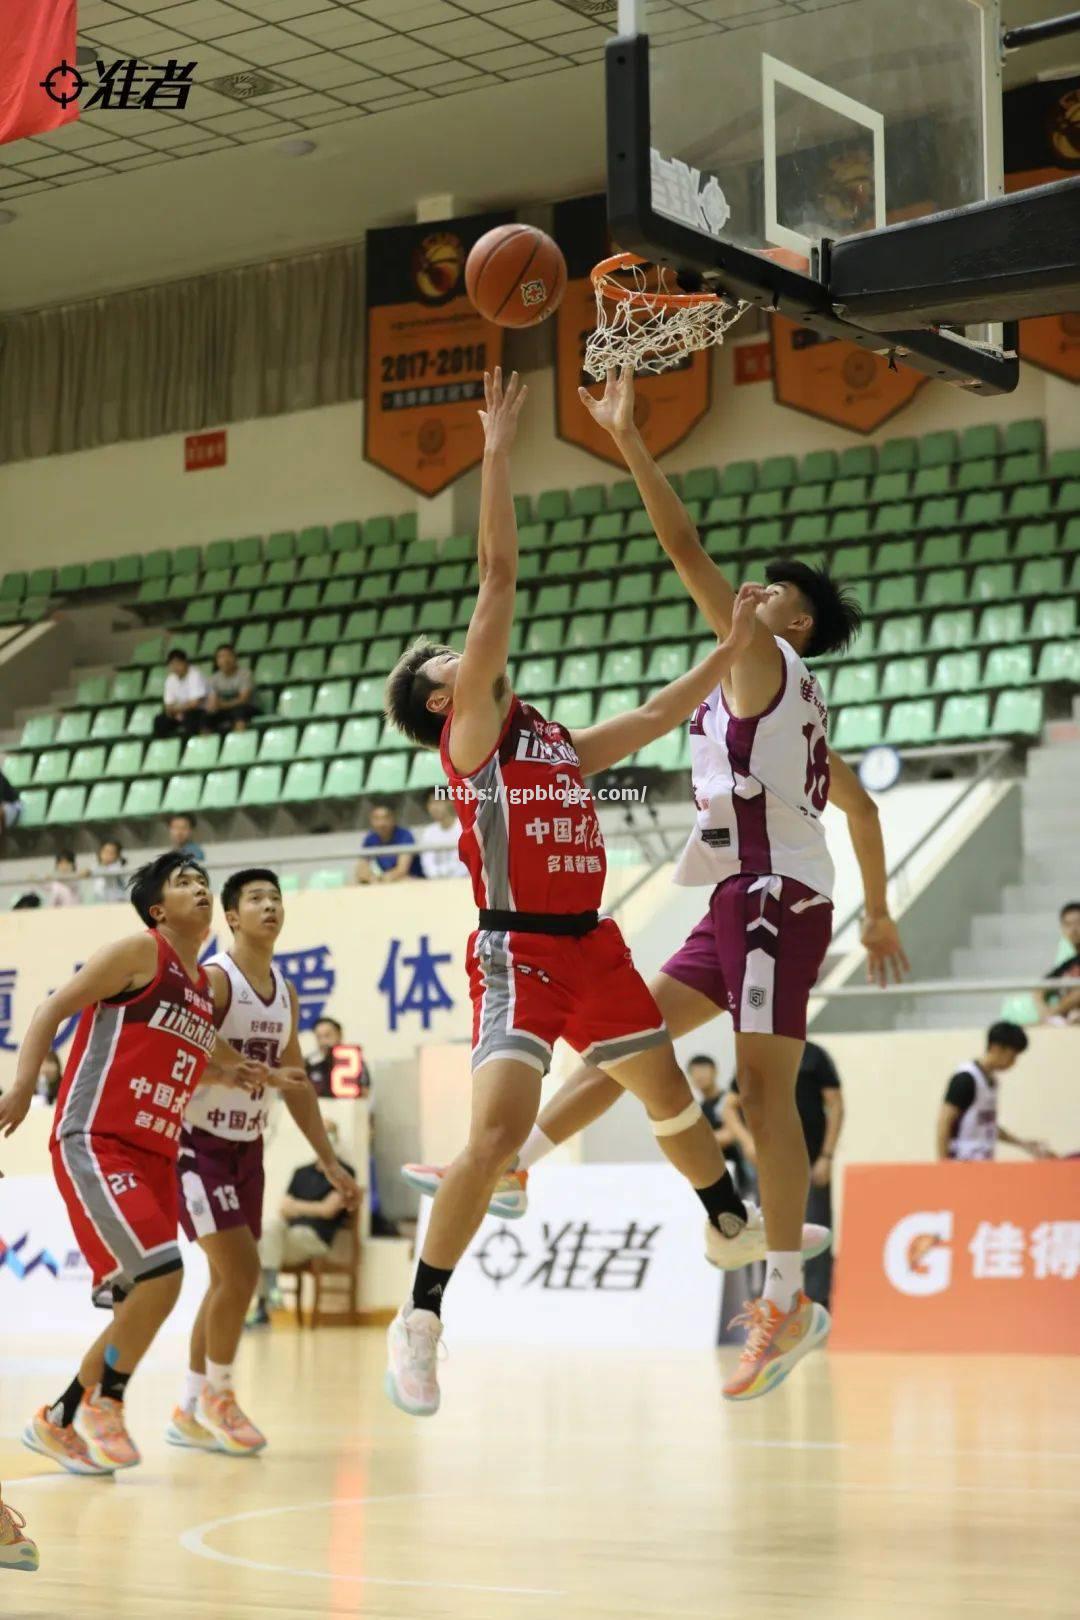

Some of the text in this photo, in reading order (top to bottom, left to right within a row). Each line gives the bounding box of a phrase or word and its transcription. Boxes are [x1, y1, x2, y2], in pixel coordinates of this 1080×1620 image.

[171, 1048, 197, 1085] 27
[331, 1045, 362, 1098] 2
[213, 1184, 240, 1211] 13
[523, 1222, 662, 1290] 准者
[884, 1210, 954, 1297] G
